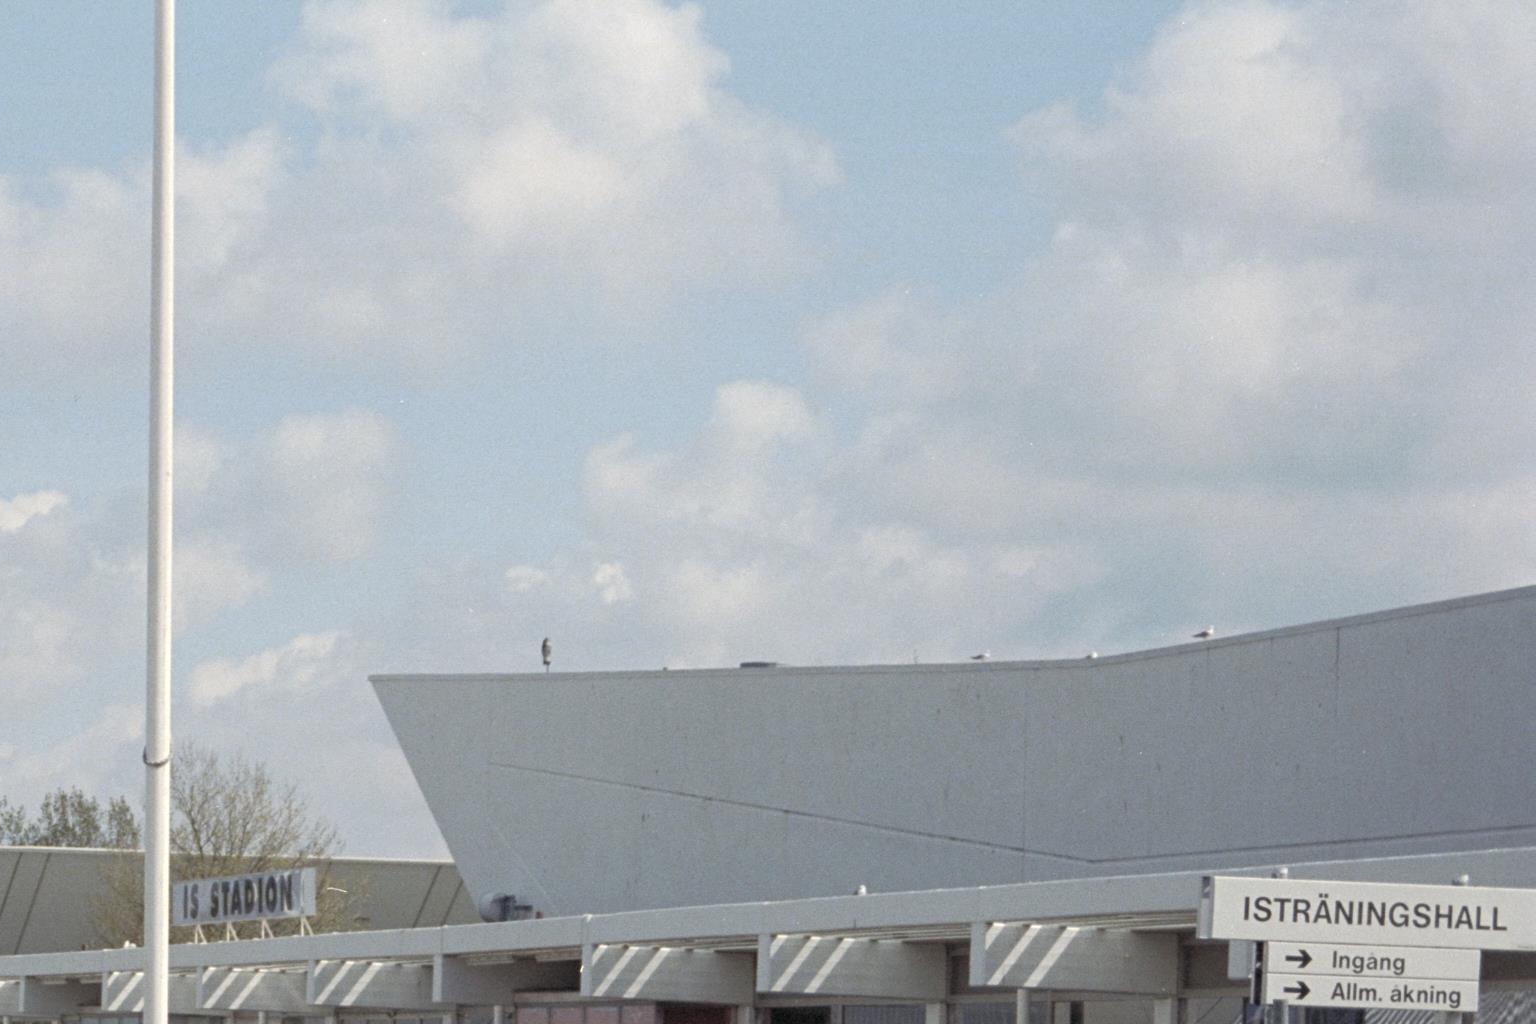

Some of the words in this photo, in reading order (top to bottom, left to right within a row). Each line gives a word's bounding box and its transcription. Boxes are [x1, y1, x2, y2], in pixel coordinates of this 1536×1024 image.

[183, 884, 199, 919] IS
[210, 874, 293, 918] STADION
[1243, 893, 1508, 932] ISTRÄNINGSHALL
[1332, 951, 1406, 975] Ingång
[1331, 982, 1383, 1003] Allm.
[1390, 984, 1462, 1009] åkning
